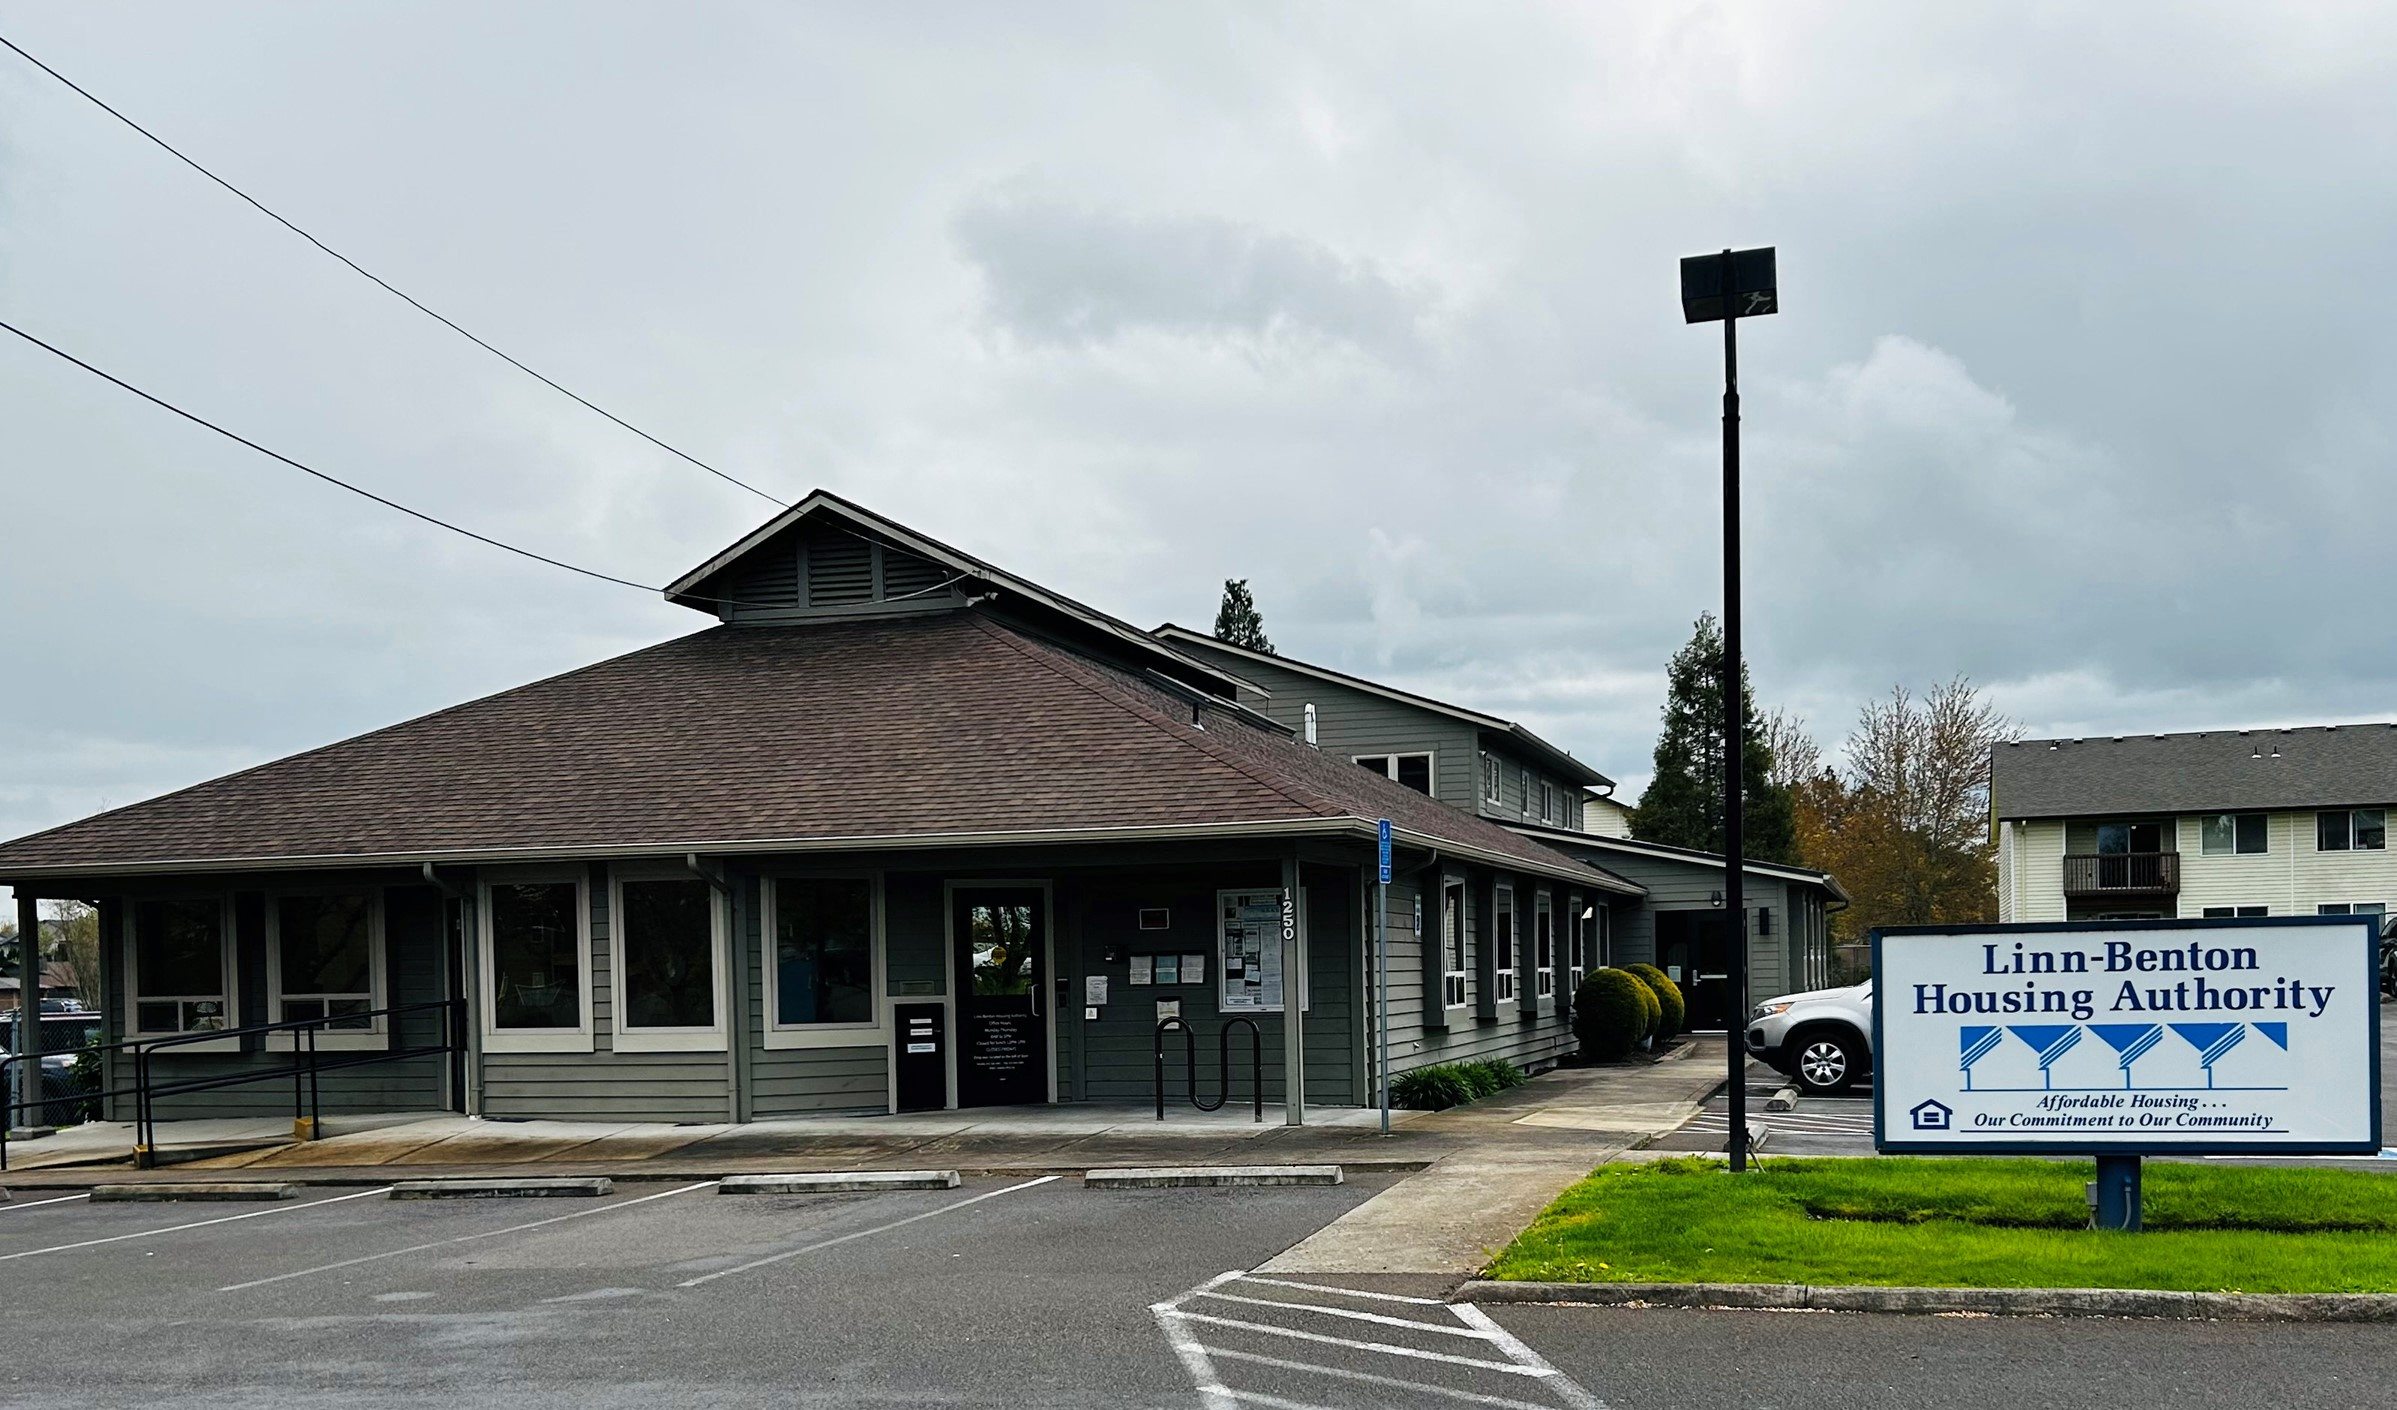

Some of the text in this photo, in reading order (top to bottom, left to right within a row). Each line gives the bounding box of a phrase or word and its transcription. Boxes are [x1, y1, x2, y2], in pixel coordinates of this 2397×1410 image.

[1282, 887, 1295, 940] 1250
[1982, 941, 2260, 975] Linn-Benton
[1912, 977, 2336, 1020] Housing Authority
[2037, 1093, 2125, 1109] Affordable
[1974, 1112, 2274, 1130] Our Commitment to Our Community
